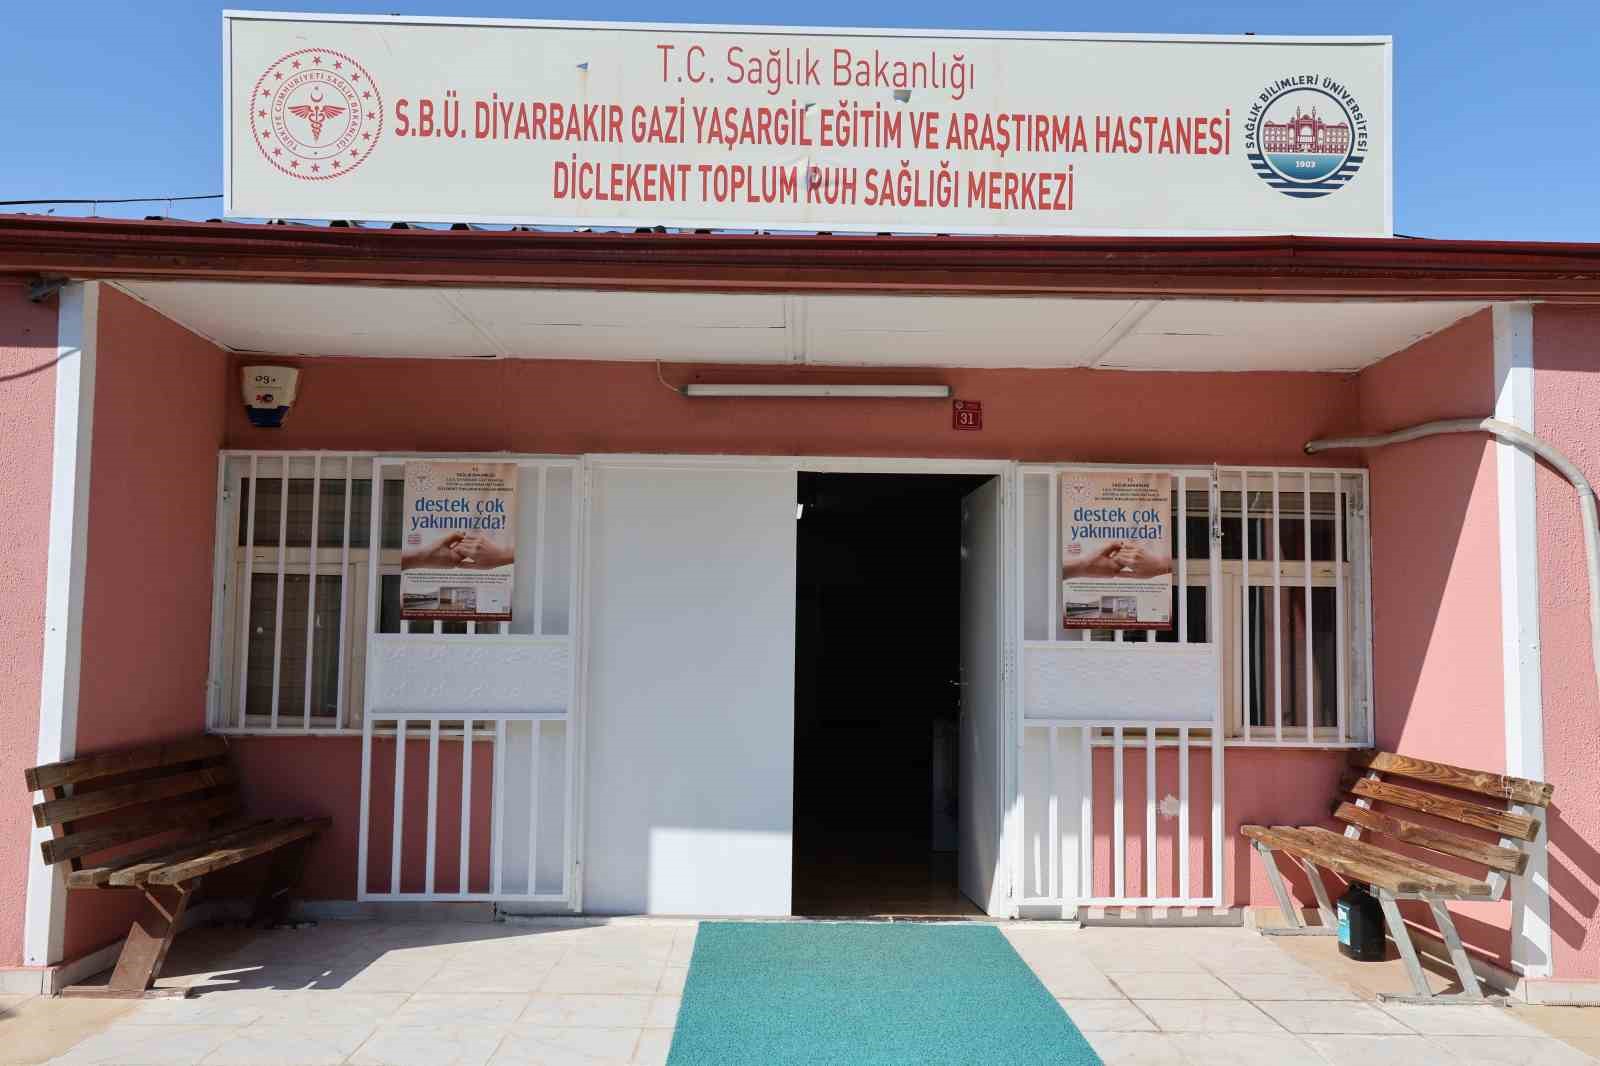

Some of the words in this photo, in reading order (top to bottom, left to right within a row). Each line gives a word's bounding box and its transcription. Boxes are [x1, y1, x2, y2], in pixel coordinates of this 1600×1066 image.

[655, 45, 714, 85] T.C.
[726, 46, 820, 95] Sağlık
[832, 48, 975, 101] Bakanlığı
[1259, 74, 1319, 103] BİLİMLERİ
[1322, 77, 1368, 152] ÜNİVERSİTESİ
[395, 90, 466, 140] S.B.Ü.
[474, 93, 624, 145] DİYARBAKIR
[631, 97, 686, 145] GAZİ
[693, 99, 813, 151] YAŞARGİL
[820, 100, 902, 149] EĞİTİM
[909, 112, 940, 150] VE
[946, 112, 1088, 158] ARAŞTIRMA
[1095, 109, 1232, 156] HASTANESİ
[553, 153, 692, 202] DİCLEKENT
[698, 163, 799, 204] TOPLUM
[806, 166, 858, 206] RUH
[863, 160, 960, 209] SAĞLIĞI
[967, 164, 1075, 211] MERKEZİ
[960, 412, 974, 425] 31
[415, 497, 469, 512] destek
[476, 497, 505, 515] çok
[411, 514, 506, 531] yakınınızda!
[1073, 507, 1126, 522] destek
[1132, 508, 1160, 524] çok
[1071, 524, 1163, 540] yakınınızda!
